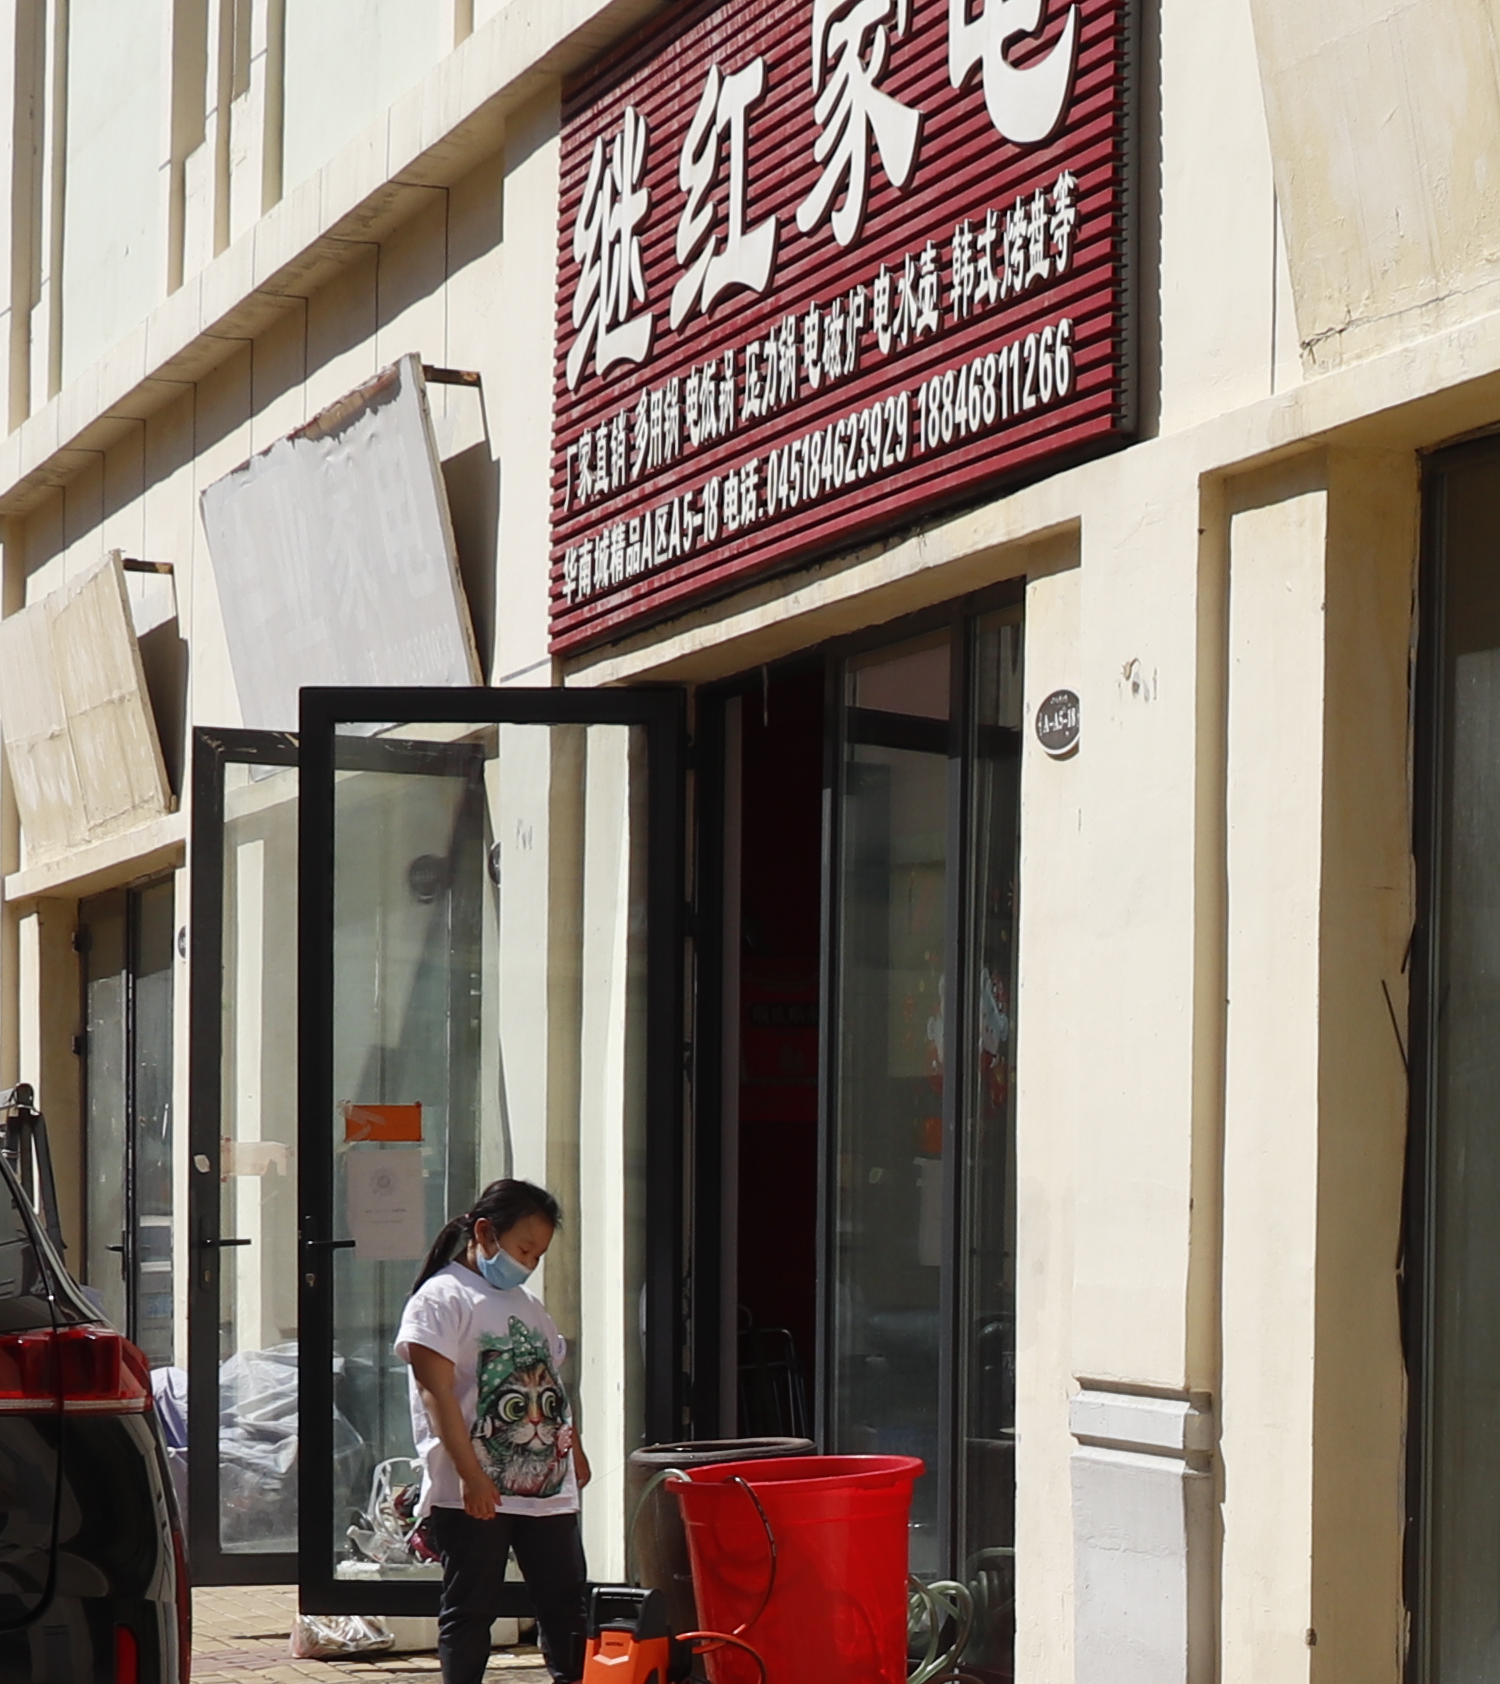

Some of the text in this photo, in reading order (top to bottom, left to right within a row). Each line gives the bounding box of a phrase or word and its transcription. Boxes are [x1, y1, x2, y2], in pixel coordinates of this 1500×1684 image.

[564, 169, 1077, 512] 厂家直销 多用锅 电饭锅 压力锅 电磁炉 电水壶 韩式烤盘等
[566, 0, 1076, 391] 继红家电
[918, 318, 1073, 452] 18846811266
